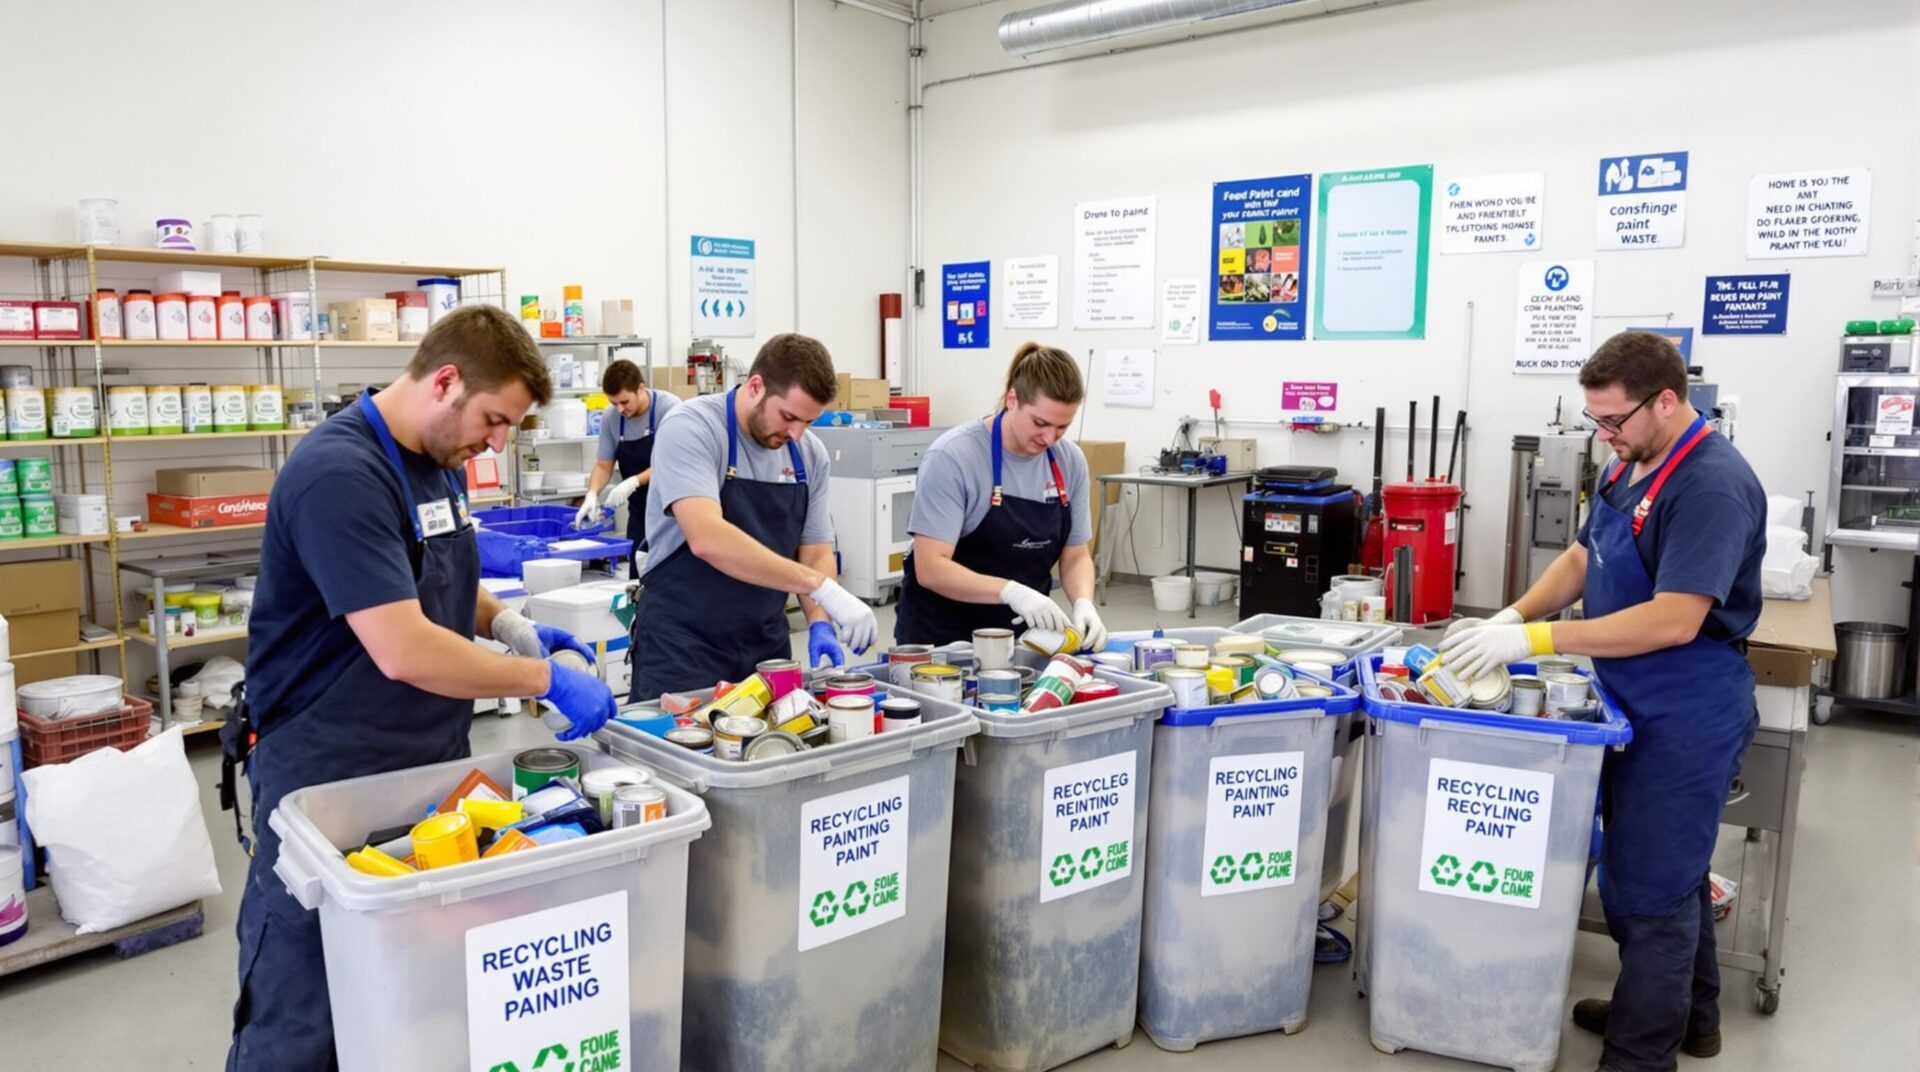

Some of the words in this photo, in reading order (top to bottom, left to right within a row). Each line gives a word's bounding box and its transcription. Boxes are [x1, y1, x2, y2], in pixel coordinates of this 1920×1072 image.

[1832, 176, 1850, 185] THE
[1457, 211, 1476, 221] AND
[1795, 203, 1805, 212] IN
[1616, 219, 1651, 233] paint
[1757, 218, 1771, 227] DO
[1803, 228, 1820, 237] THE
[1803, 239, 1820, 249] THE
[1215, 766, 1297, 785] RECYCLING
[1053, 772, 1129, 800] RECYCLEG
[1225, 784, 1289, 802] PAINTING
[1437, 777, 1540, 804] RECYCLING
[1056, 792, 1119, 818] REINTING
[1233, 802, 1275, 819] PAINT
[1447, 797, 1532, 822] RECYLING
[1070, 811, 1110, 832] PAINT
[1465, 819, 1516, 839] PAINT
[823, 819, 890, 851] PAINTING
[836, 840, 879, 867] PAINT
[1504, 867, 1534, 882] FOUR
[482, 922, 612, 973] RECYCLING
[512, 953, 592, 992] WASTE
[505, 977, 600, 1022] PAINING
